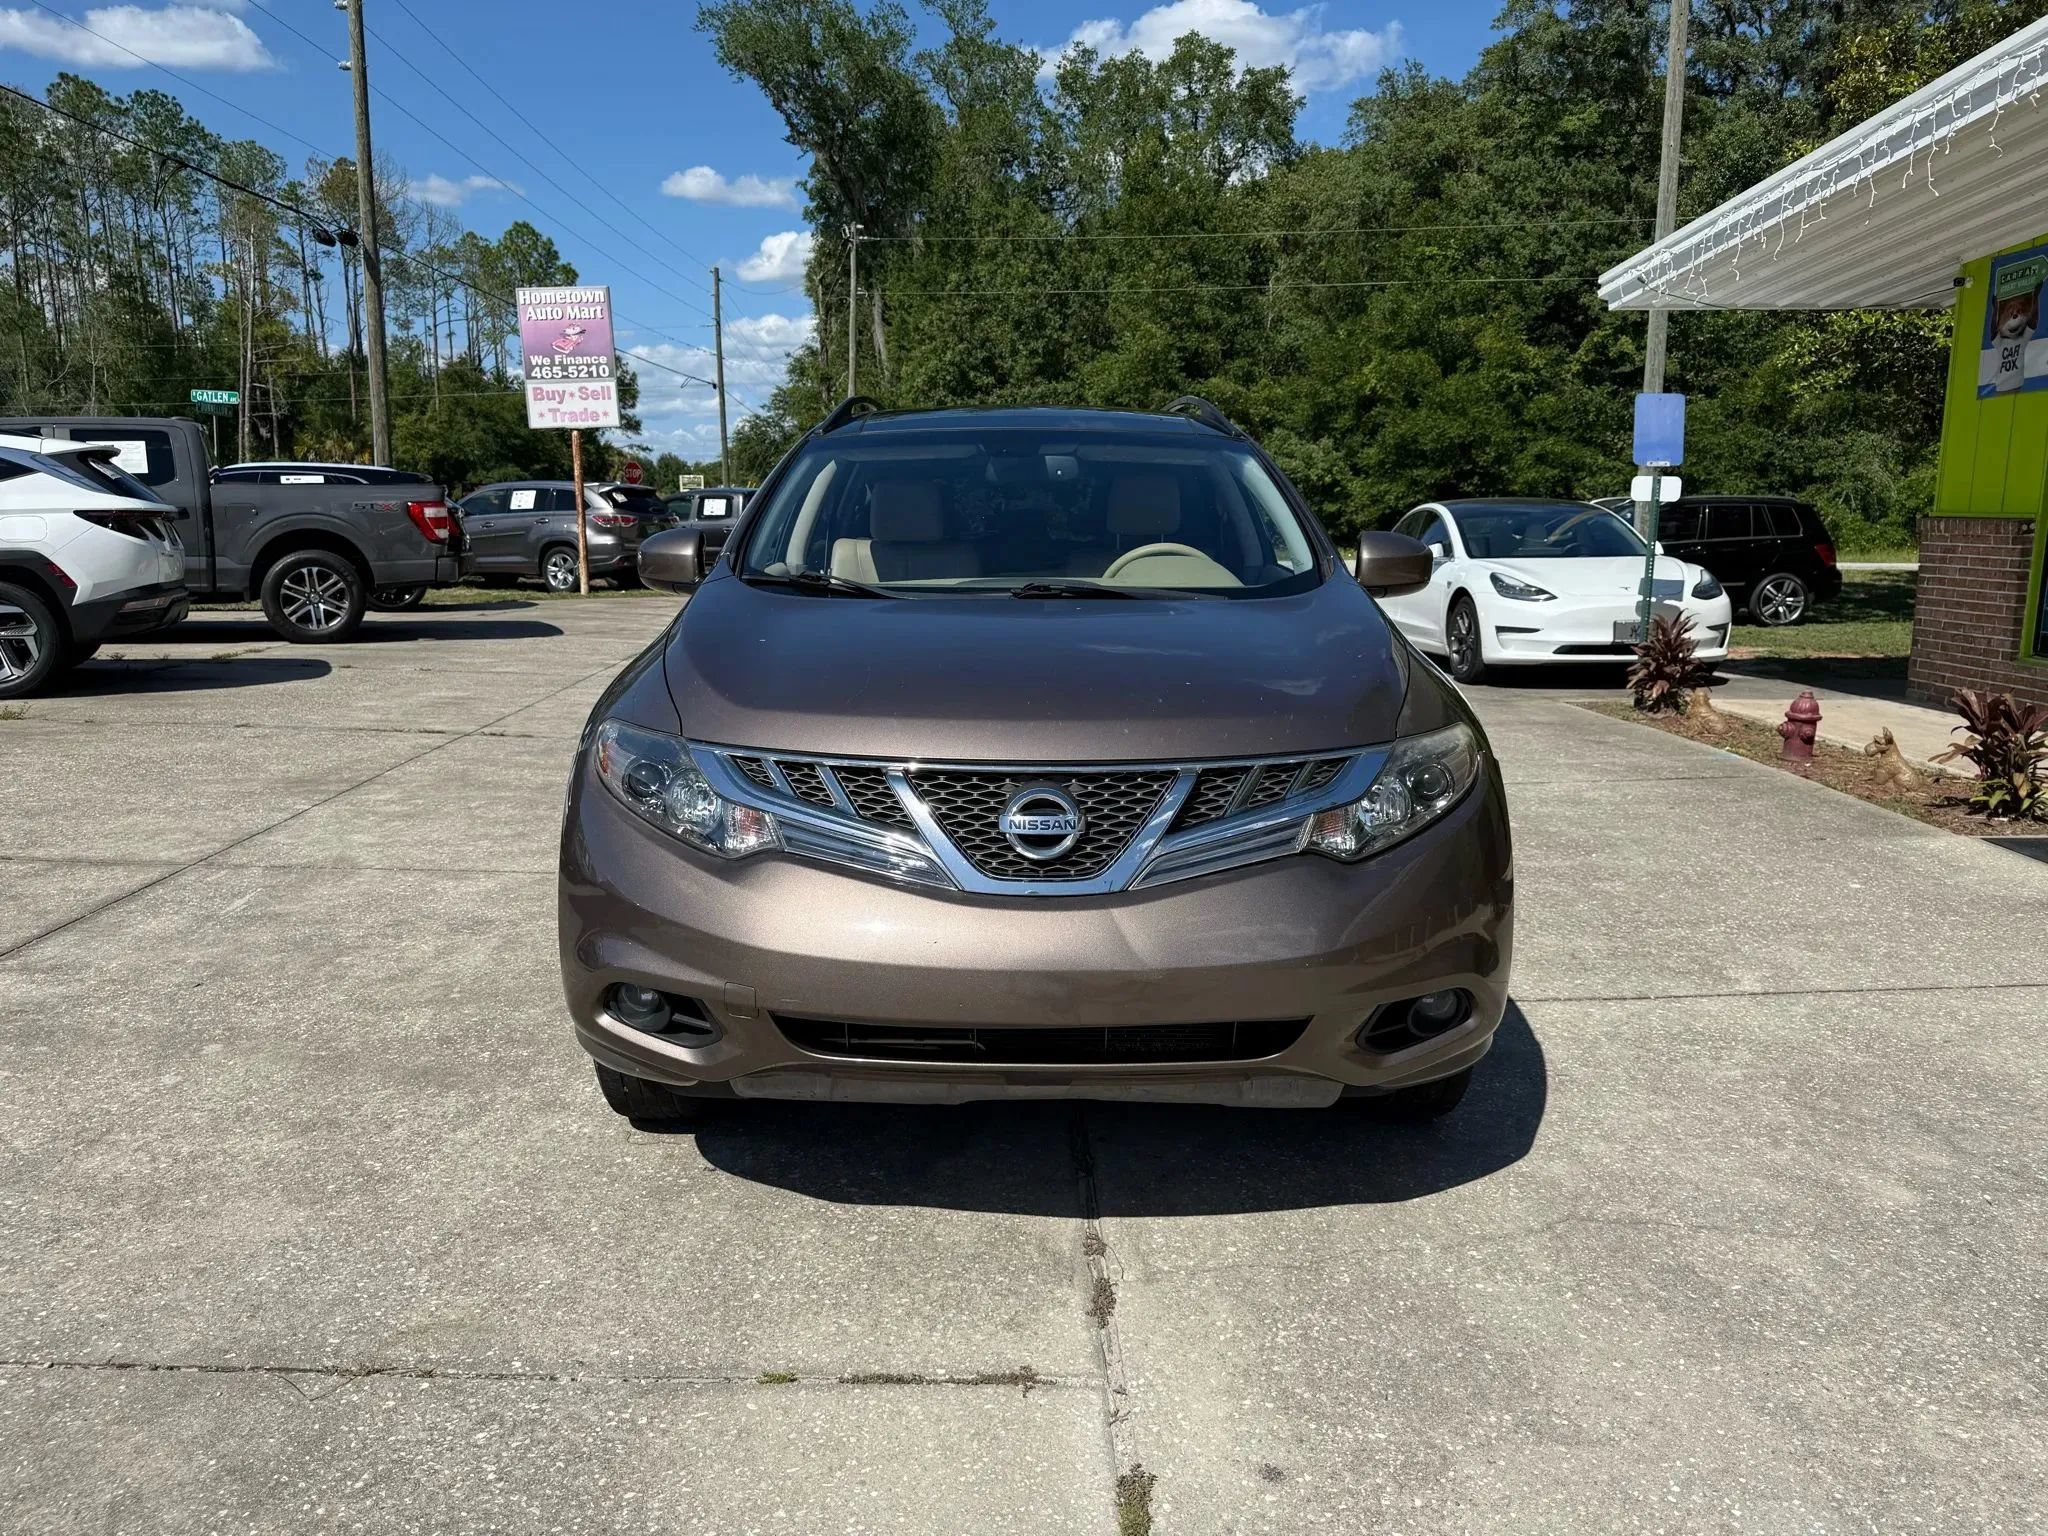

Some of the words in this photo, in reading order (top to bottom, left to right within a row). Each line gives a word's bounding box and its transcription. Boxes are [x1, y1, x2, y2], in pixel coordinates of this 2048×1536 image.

[518, 290, 605, 305] Hometown
[526, 306, 563, 321] Auto
[567, 306, 604, 320] Mart
[2002, 344, 2021, 360] CAR
[530, 355, 551, 366] We
[554, 355, 608, 365] Finance
[2000, 358, 2018, 374] FOX
[530, 365, 610, 379] 465-5210
[532, 387, 566, 404] Buy
[578, 386, 611, 401] Sell
[548, 408, 600, 423] Trade
[625, 468, 641, 478] STOP
[1008, 819, 1076, 831] NISSAN
